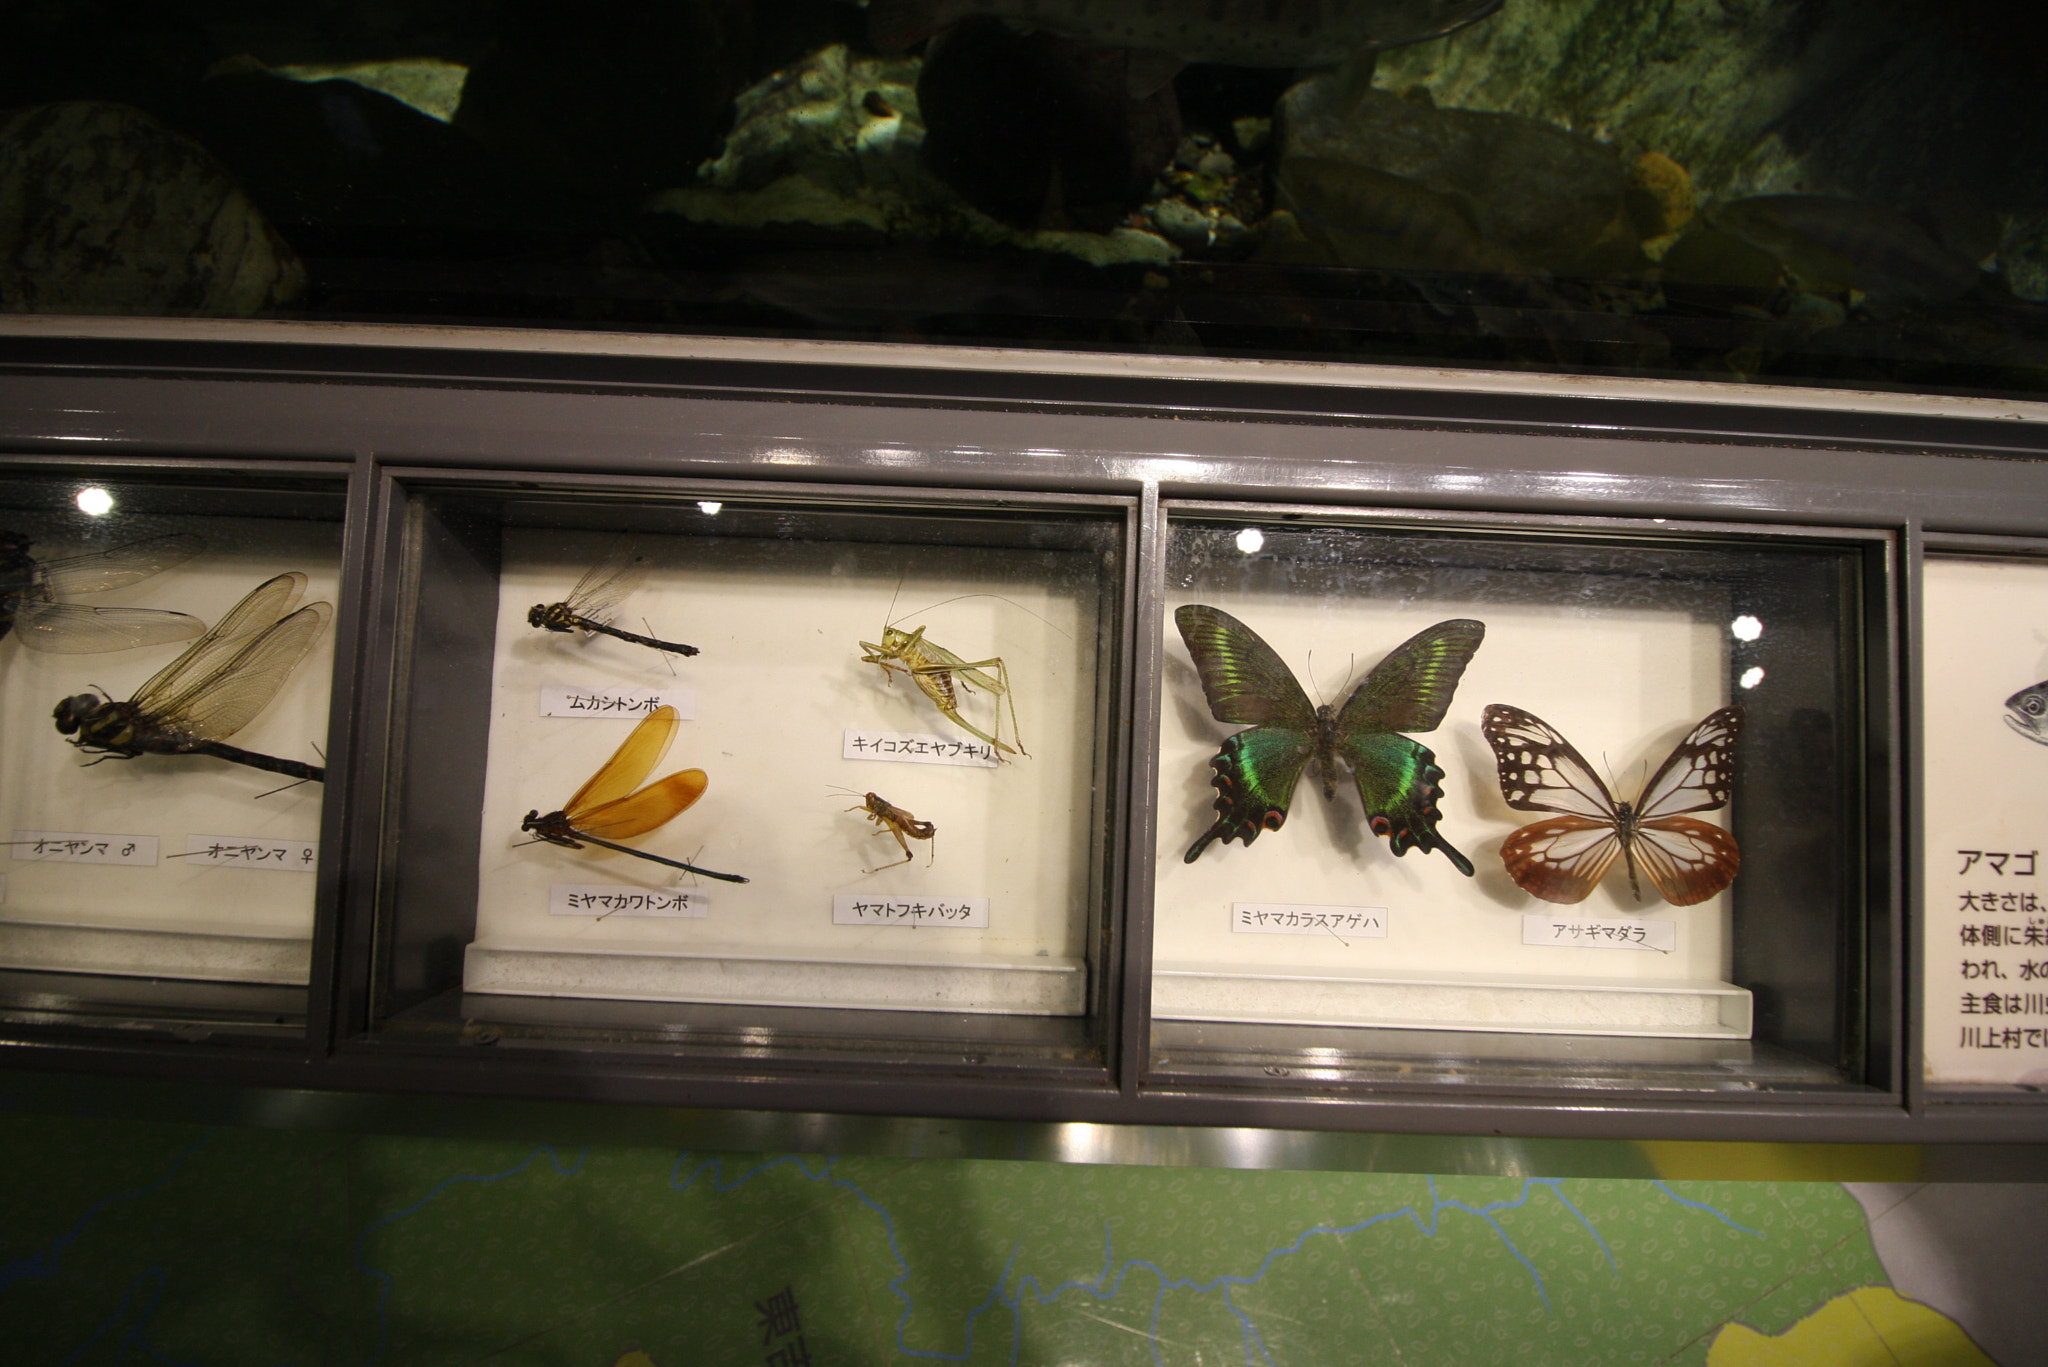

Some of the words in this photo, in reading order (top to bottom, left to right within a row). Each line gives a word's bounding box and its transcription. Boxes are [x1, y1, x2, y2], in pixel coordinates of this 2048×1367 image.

[570, 695, 660, 712] ムカシトンボ
[852, 736, 991, 760] キイコズエヤブキリ
[33, 838, 109, 856] オニヤンマ
[208, 842, 287, 861] オニヤンマ
[1957, 850, 2039, 875] アマゴ
[568, 893, 689, 911] ミヤマカワトンボ
[1959, 890, 2048, 912] 大きさは、
[852, 902, 971, 920] ヤマトフキバッタ
[1242, 910, 1380, 929] ミヤマカラスアゲハ
[1552, 924, 1646, 942] アサギマダラ
[1960, 924, 2048, 946] 体側に朱
[1960, 992, 2048, 1015] 主食は川
[1960, 1026, 2048, 1049] 川上村で
